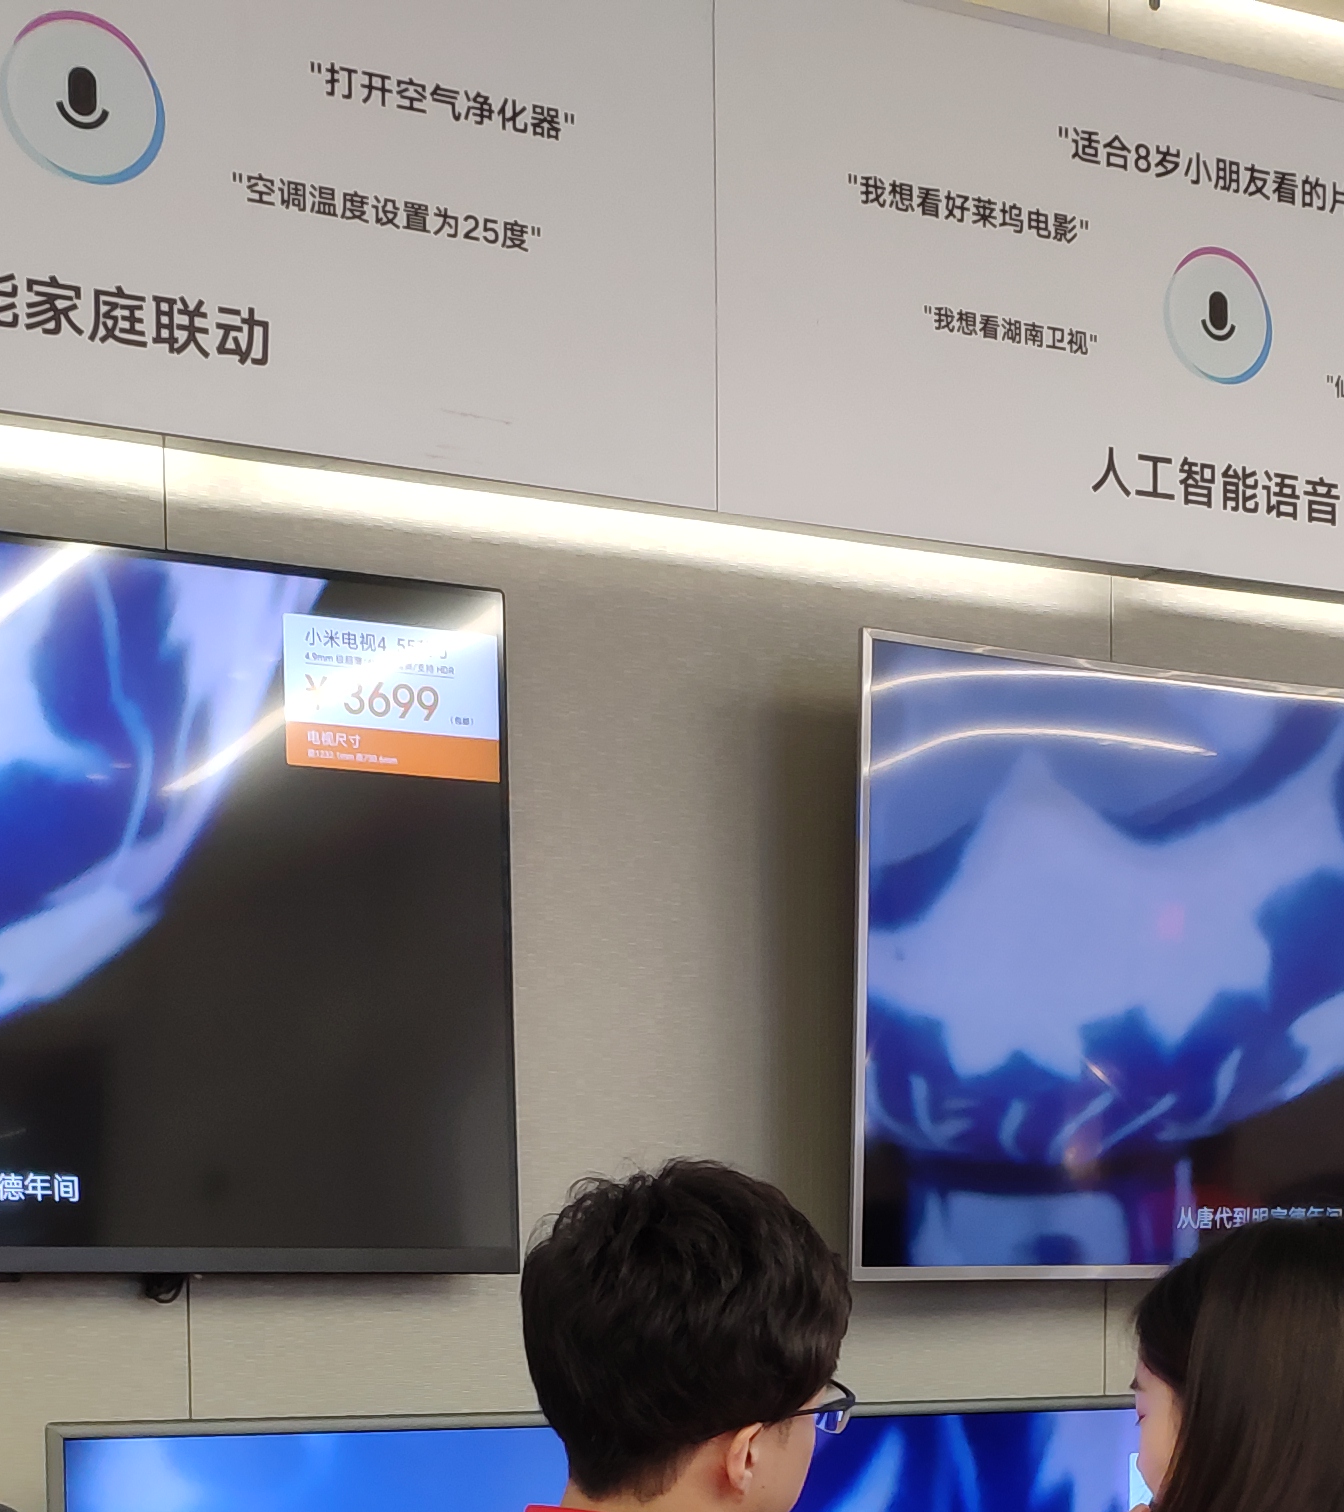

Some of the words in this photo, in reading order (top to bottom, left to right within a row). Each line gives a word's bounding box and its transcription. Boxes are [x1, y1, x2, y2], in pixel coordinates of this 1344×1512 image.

[310, 61, 575, 141] "打开空气净化器"
[232, 172, 541, 253] "空调温度设置为25度"
[847, 173, 1089, 245] "我想看好莱坞电影"
[923, 305, 1098, 356] "我想看湖南卫视"
[1091, 447, 1341, 527] 人工智能语音
[344, 681, 439, 721] 3699
